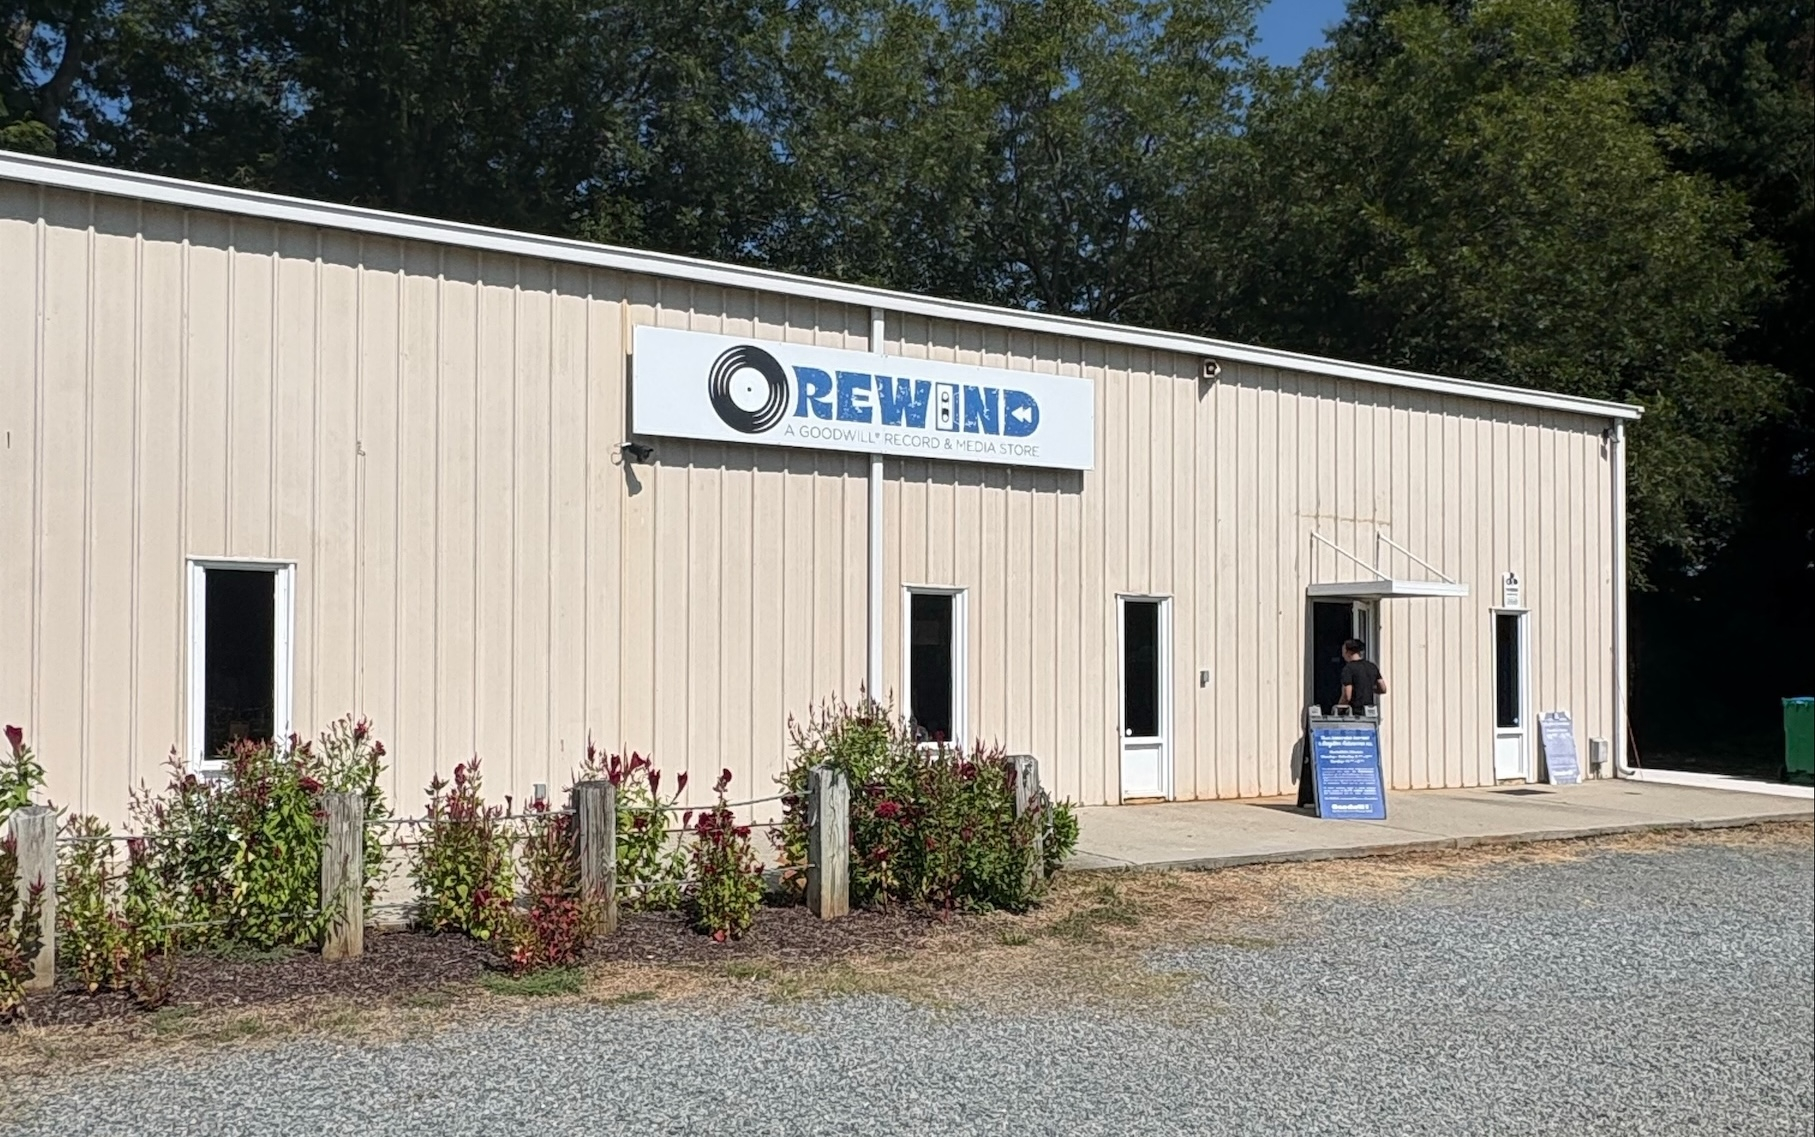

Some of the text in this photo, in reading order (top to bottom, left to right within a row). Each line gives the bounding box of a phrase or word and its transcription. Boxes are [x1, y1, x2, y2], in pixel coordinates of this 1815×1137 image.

[784, 423, 795, 437] A
[884, 433, 941, 449] RECORD
[943, 437, 953, 450] &
[956, 439, 996, 454] MEDIA
[999, 443, 1040, 457] STORE
